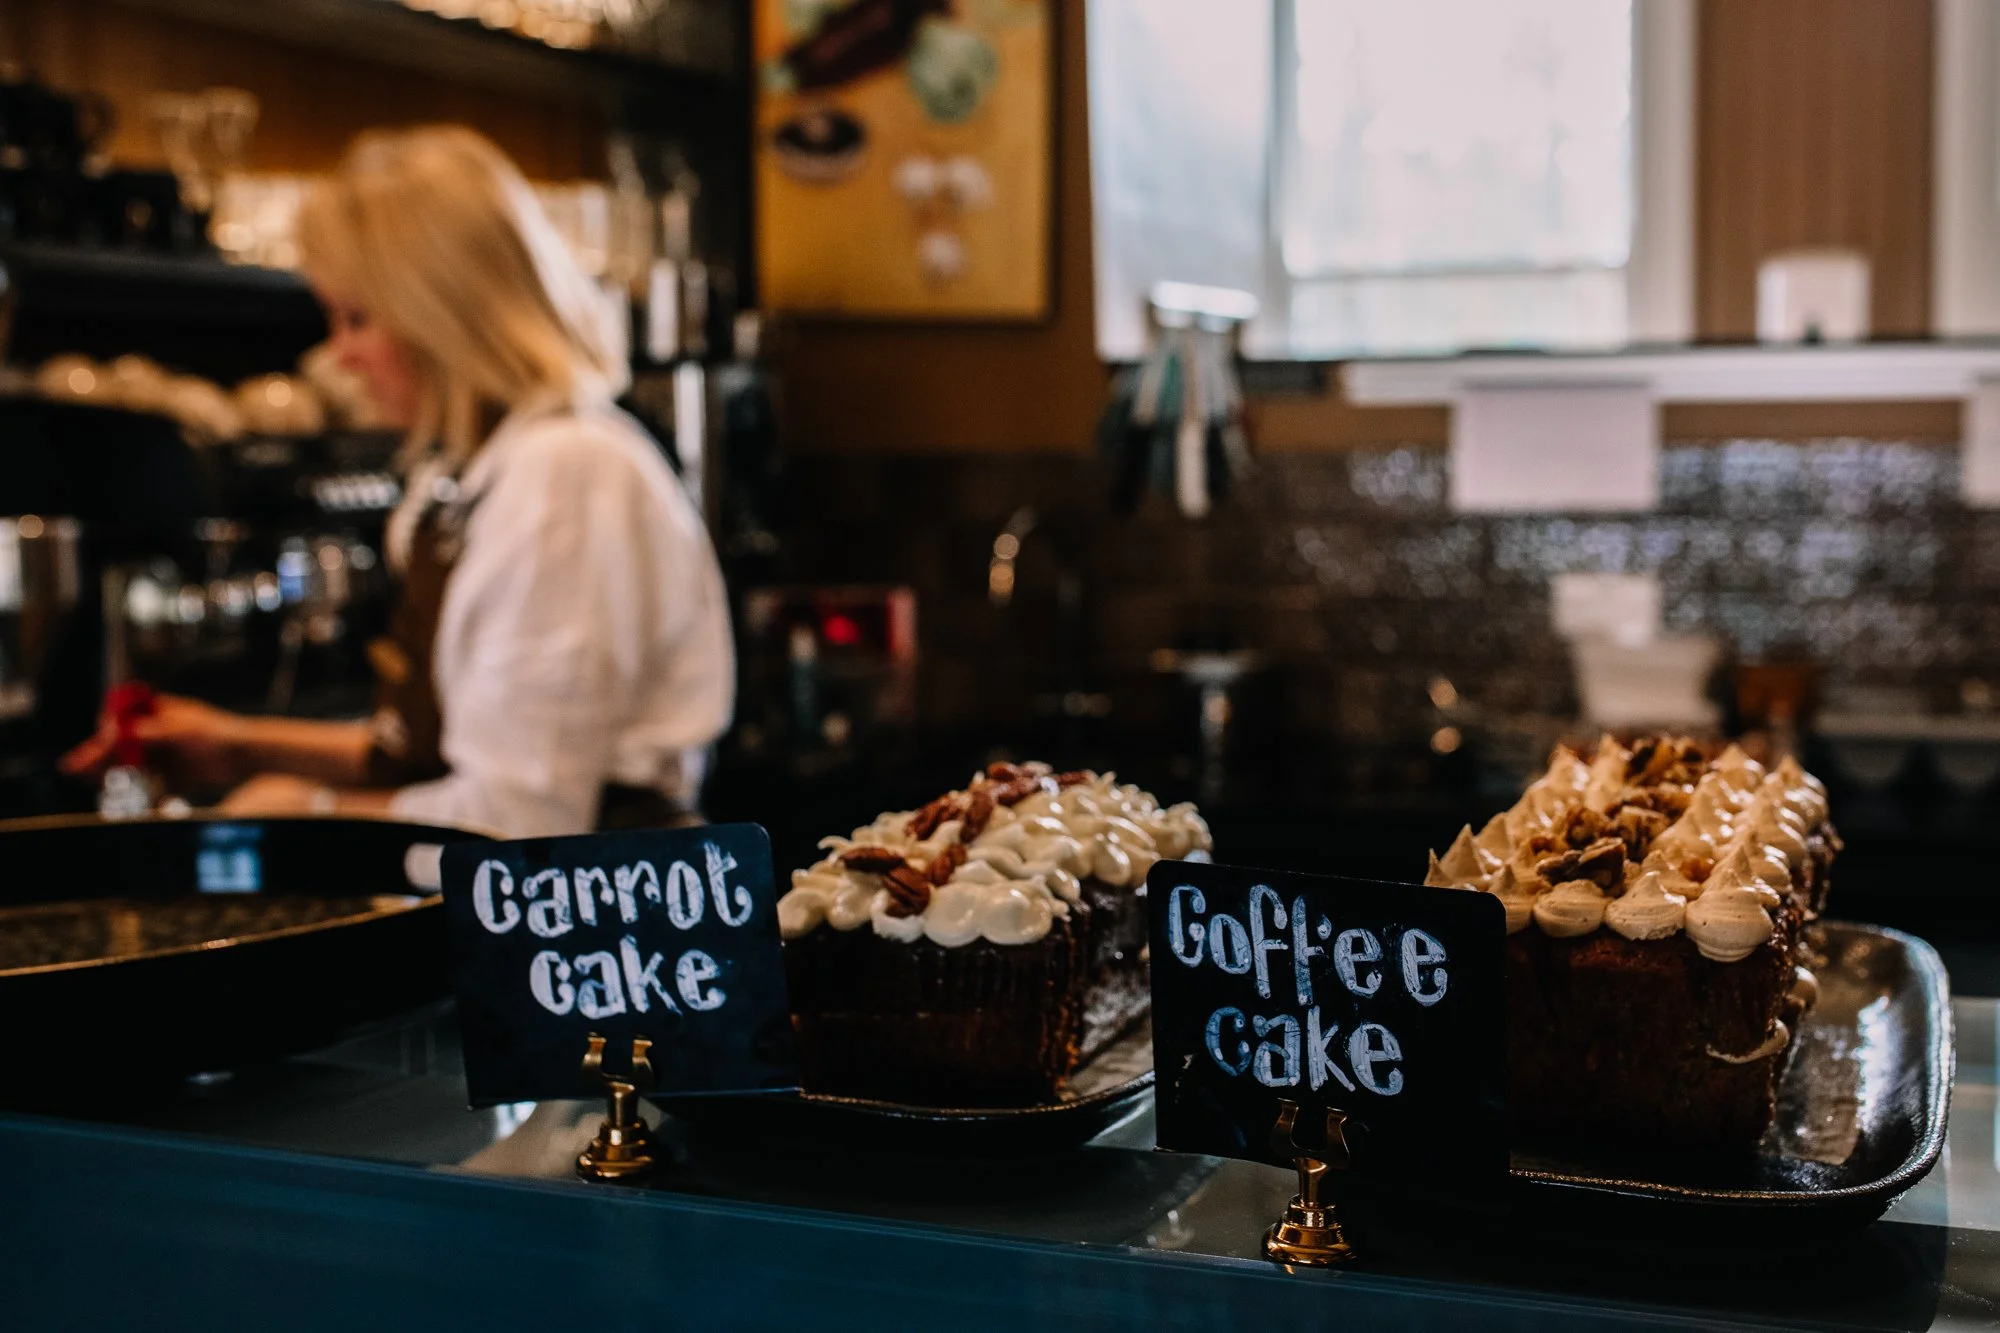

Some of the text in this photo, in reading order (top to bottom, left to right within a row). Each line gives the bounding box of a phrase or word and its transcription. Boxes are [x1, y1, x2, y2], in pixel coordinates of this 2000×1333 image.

[473, 841, 752, 938] Carrot
[529, 934, 727, 1019] cake
[1168, 884, 1448, 1006] Coffee
[1205, 1005, 1403, 1096] cake
